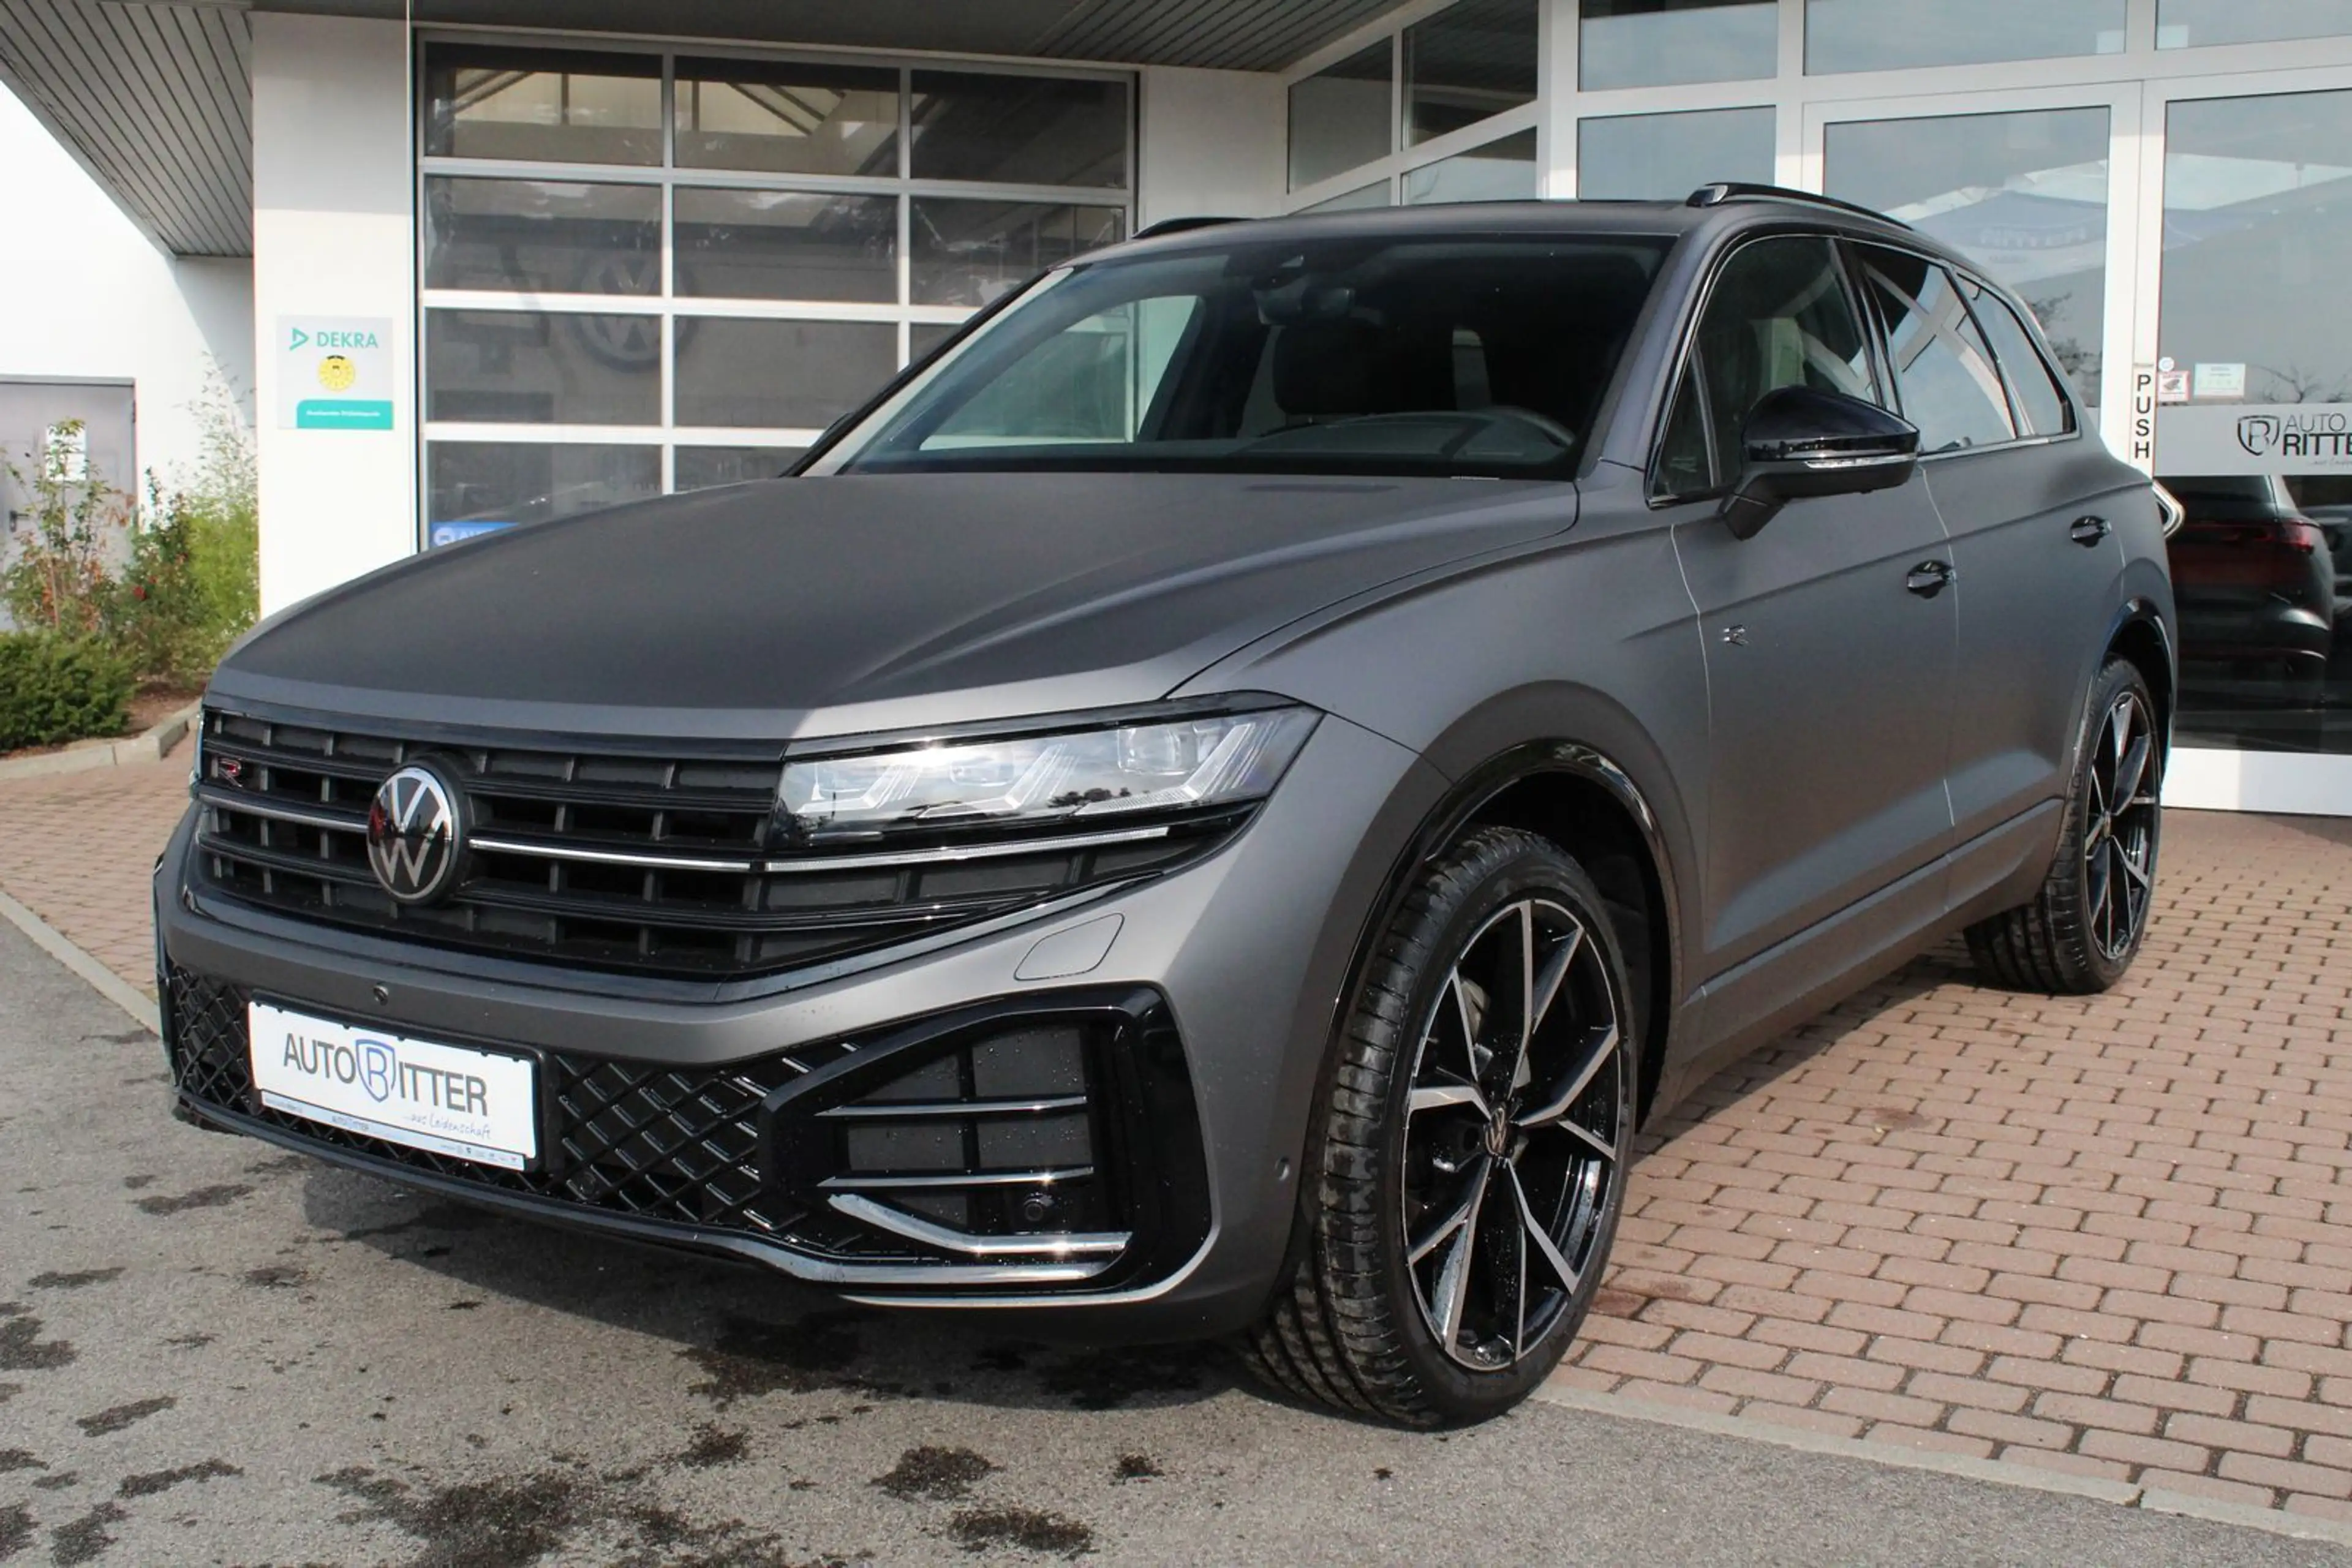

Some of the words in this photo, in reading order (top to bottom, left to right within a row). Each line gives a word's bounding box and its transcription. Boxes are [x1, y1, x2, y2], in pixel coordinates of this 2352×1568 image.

[317, 331, 379, 349] DEKRA
[2134, 374, 2152, 459] PUSH
[2283, 413, 2346, 432] AUTO
[284, 1033, 356, 1084] AUTO
